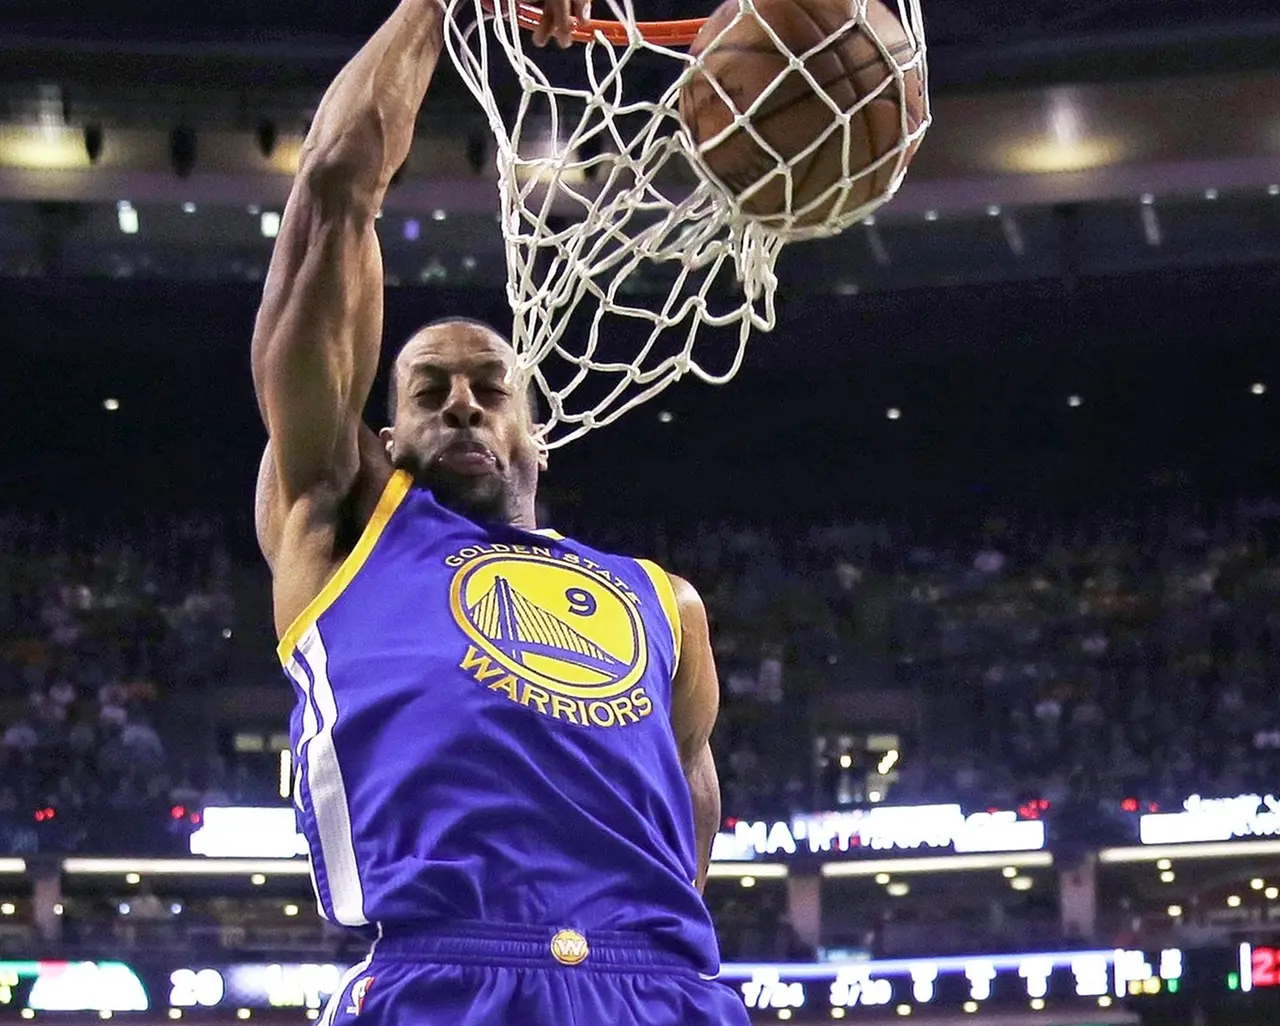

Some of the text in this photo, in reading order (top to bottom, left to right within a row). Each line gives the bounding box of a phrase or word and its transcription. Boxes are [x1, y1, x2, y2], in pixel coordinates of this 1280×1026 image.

[444, 542, 643, 607] GOLDEN STATE
[564, 587, 597, 617] 9
[459, 644, 653, 729] WARRIORS
